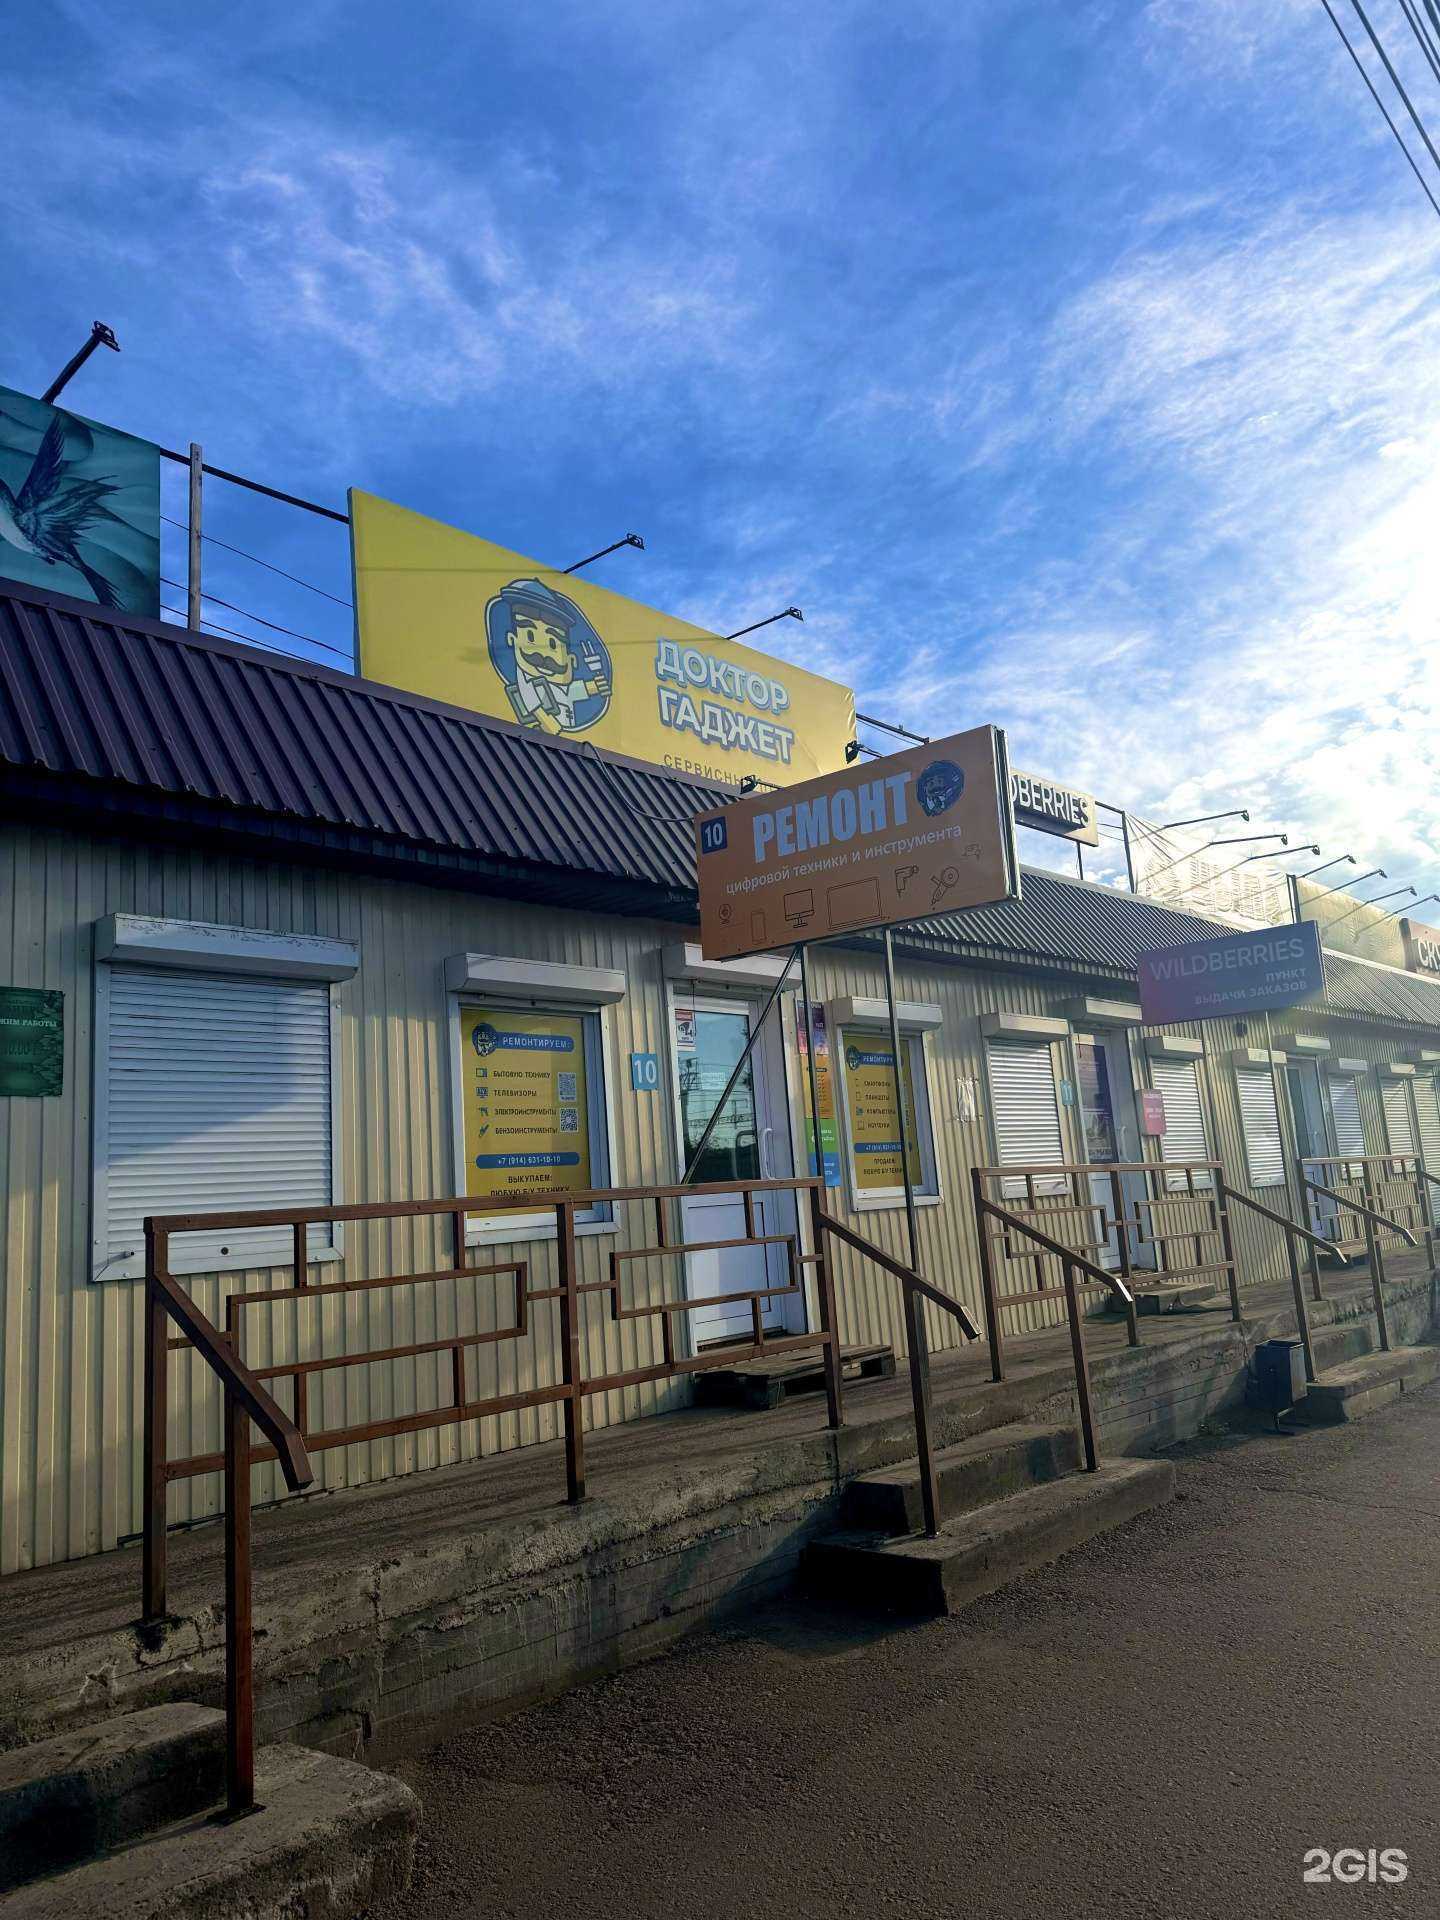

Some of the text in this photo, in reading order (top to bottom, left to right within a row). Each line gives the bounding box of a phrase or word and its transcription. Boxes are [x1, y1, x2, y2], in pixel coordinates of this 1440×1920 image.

[655, 638, 791, 714] ДОКТОР
[657, 687, 794, 763] ГАДЖЕТ
[663, 754, 741, 784] СЕРВИСН
[752, 772, 911, 863] РЕМОНТ
[704, 823, 724, 848] 10
[726, 825, 962, 896] цифровой техники и инструмента
[1150, 938, 1305, 981] WILDBERRIES
[1265, 967, 1307, 982] ПУНКТ
[1195, 981, 1308, 1005] ВЫДАЧИ ЗАКАЗОВ
[503, 1036, 570, 1048] РЕМОНТИРУЕМ:
[525, 1071, 551, 1079] ТЕХНИКУ
[633, 1060, 657, 1084] 10
[494, 1089, 538, 1097] ТЕЛЕВИЗОРЫ
